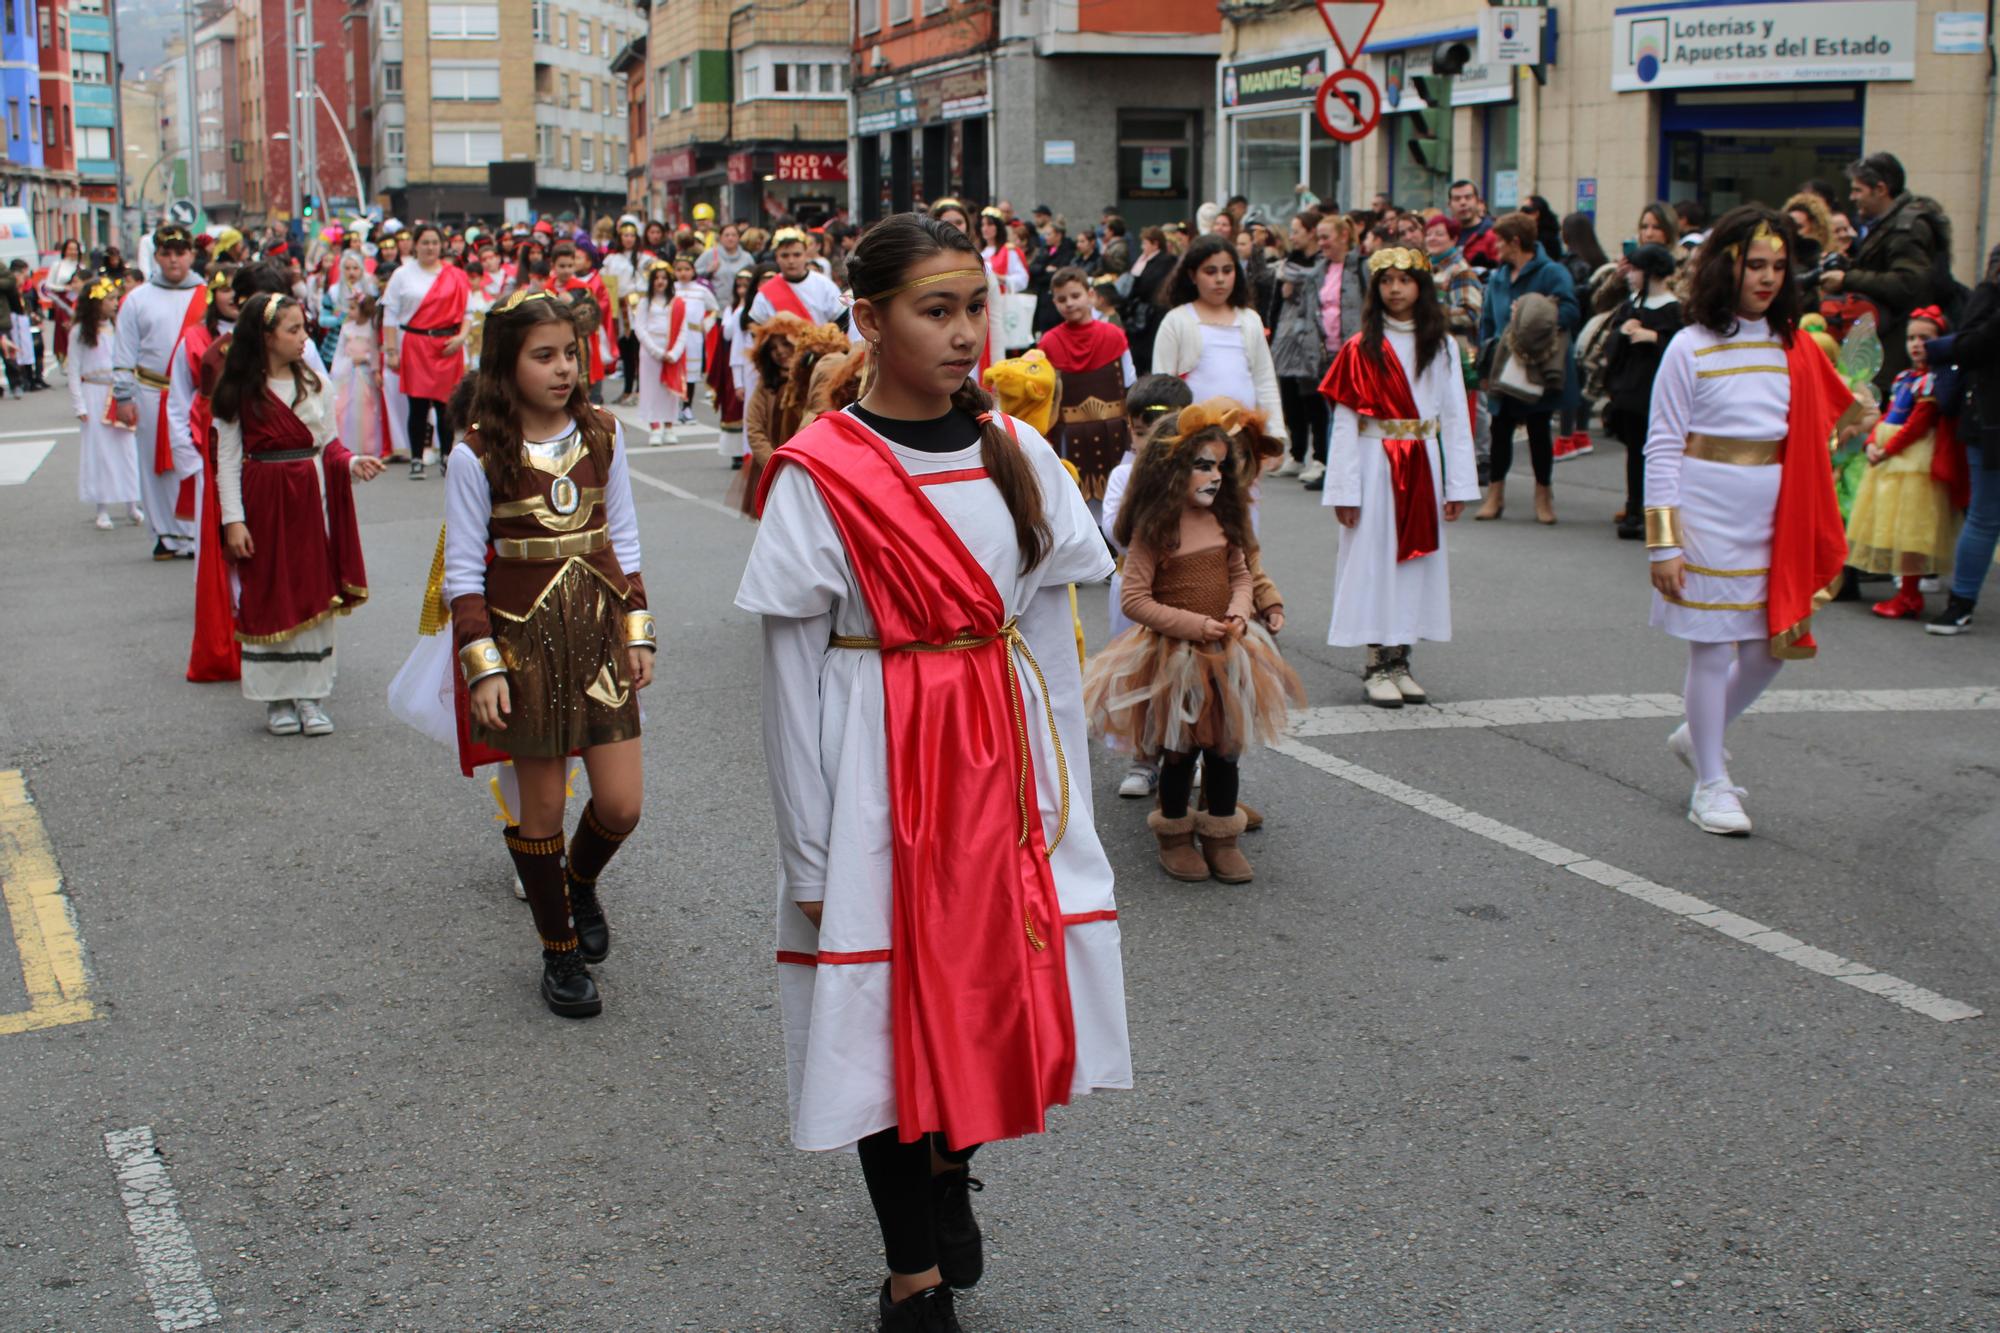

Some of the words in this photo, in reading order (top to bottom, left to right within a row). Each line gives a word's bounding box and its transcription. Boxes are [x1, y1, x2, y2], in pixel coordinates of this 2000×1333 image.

[1674, 18, 1756, 39] Loterías
[1761, 19, 1775, 40] y
[1675, 40, 1767, 64] Apuestas
[1775, 37, 1807, 57] del
[1815, 36, 1892, 57] Estado
[778, 155, 833, 167] MODA
[778, 167, 822, 180] PIEL
